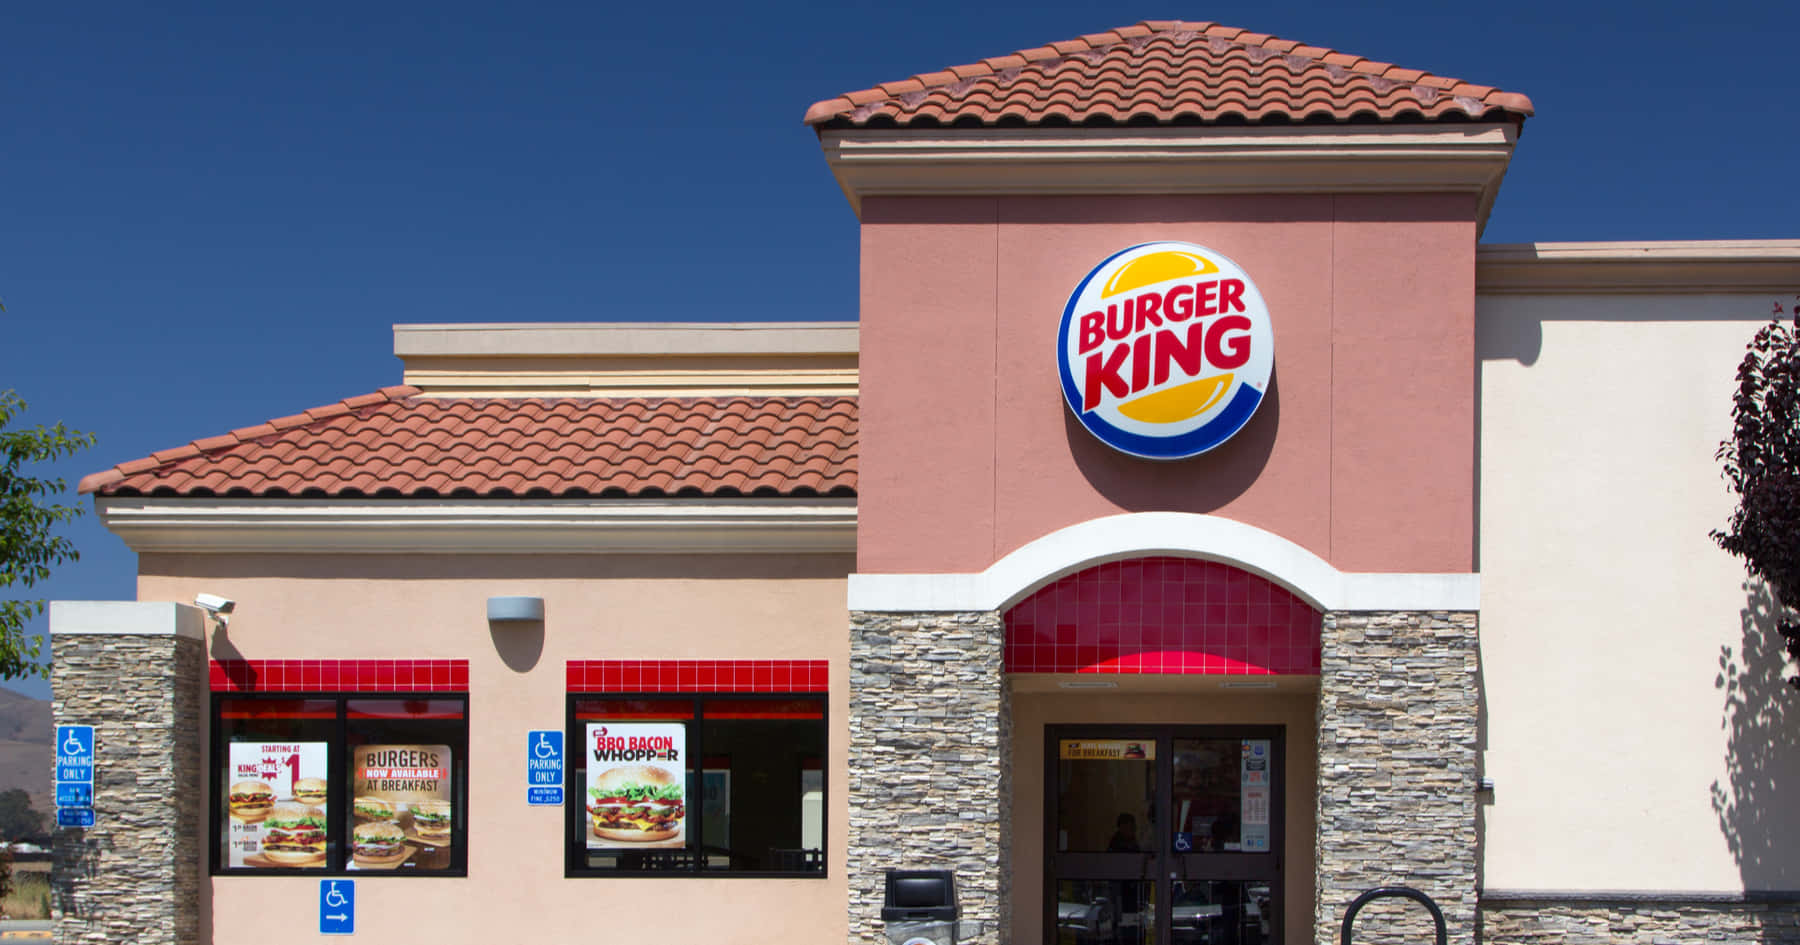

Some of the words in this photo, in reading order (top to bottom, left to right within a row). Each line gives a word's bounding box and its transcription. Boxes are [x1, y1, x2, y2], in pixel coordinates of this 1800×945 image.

[1079, 278, 1246, 356] BURGER
[1084, 314, 1252, 412] KING
[597, 736, 625, 750] BBQ
[629, 736, 673, 750] BACON
[262, 745, 292, 753] STARTING
[293, 745, 300, 753] AT
[1083, 748, 1121, 757] BREAKFAST
[57, 756, 91, 767] PARKING
[366, 750, 439, 768] BURGERS
[529, 759, 561, 770] PARKING
[238, 763, 257, 773] KING
[366, 769, 388, 778] NOW
[391, 769, 439, 778] AVAILABLE
[63, 768, 85, 780] ONLY
[535, 771, 555, 782] ONLY
[367, 780, 378, 792] AT
[381, 780, 439, 792] BREAKFAST
